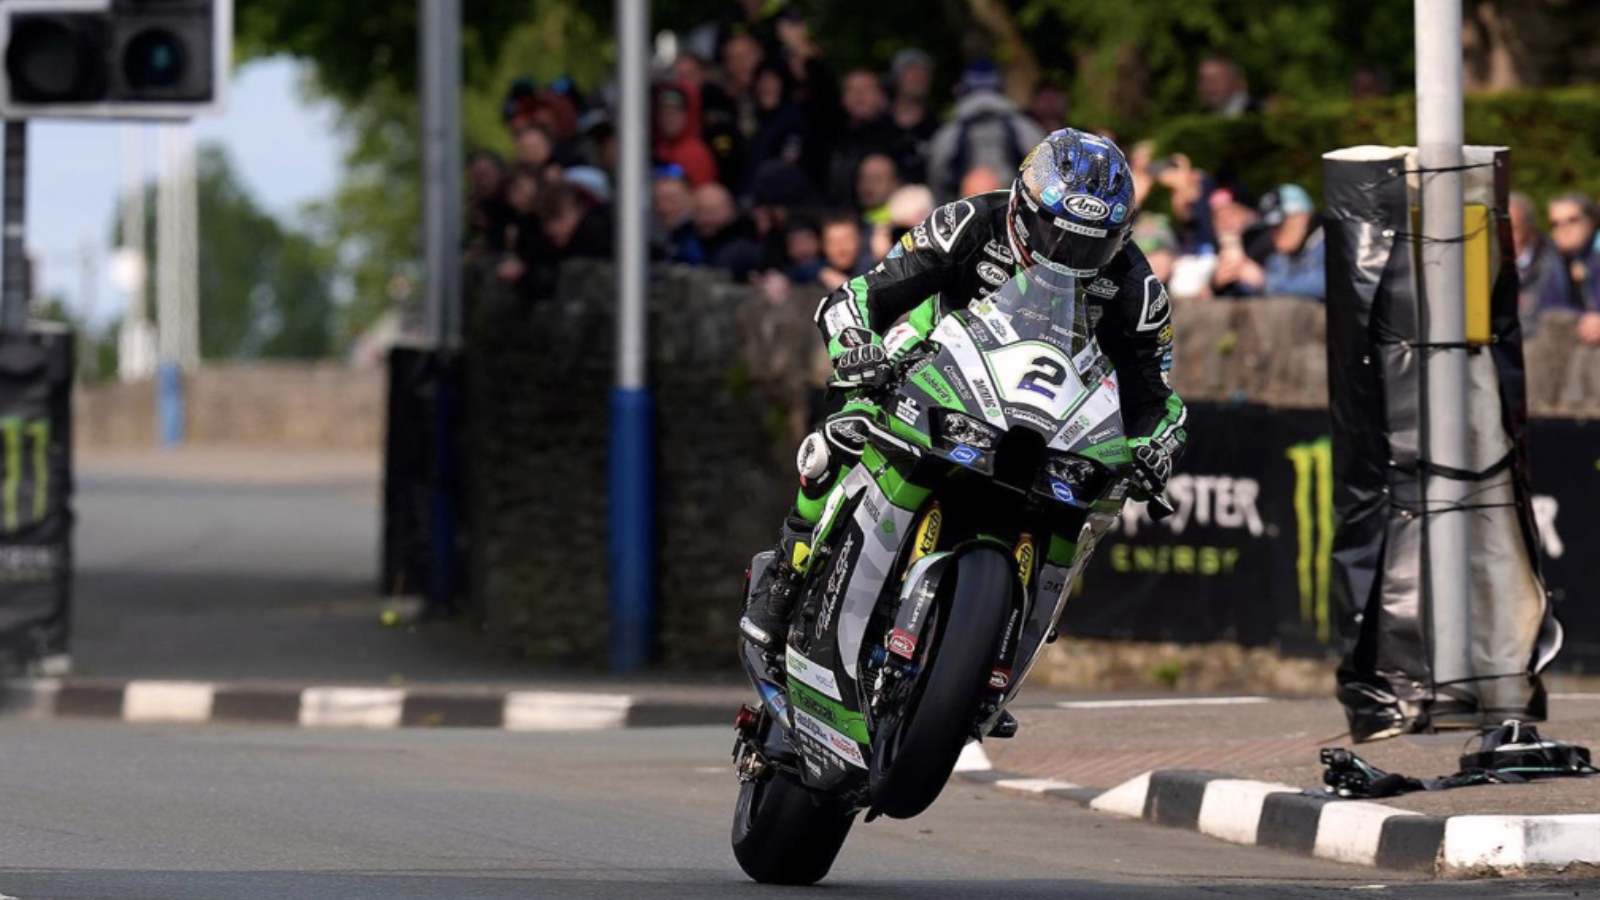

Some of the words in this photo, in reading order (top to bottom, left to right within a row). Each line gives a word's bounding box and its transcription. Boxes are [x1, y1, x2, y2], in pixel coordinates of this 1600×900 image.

[1068, 198, 1102, 213] Arai
[980, 265, 1005, 281] Arai
[1016, 355, 1067, 400] 2
[1110, 543, 1240, 575] ENERGY
